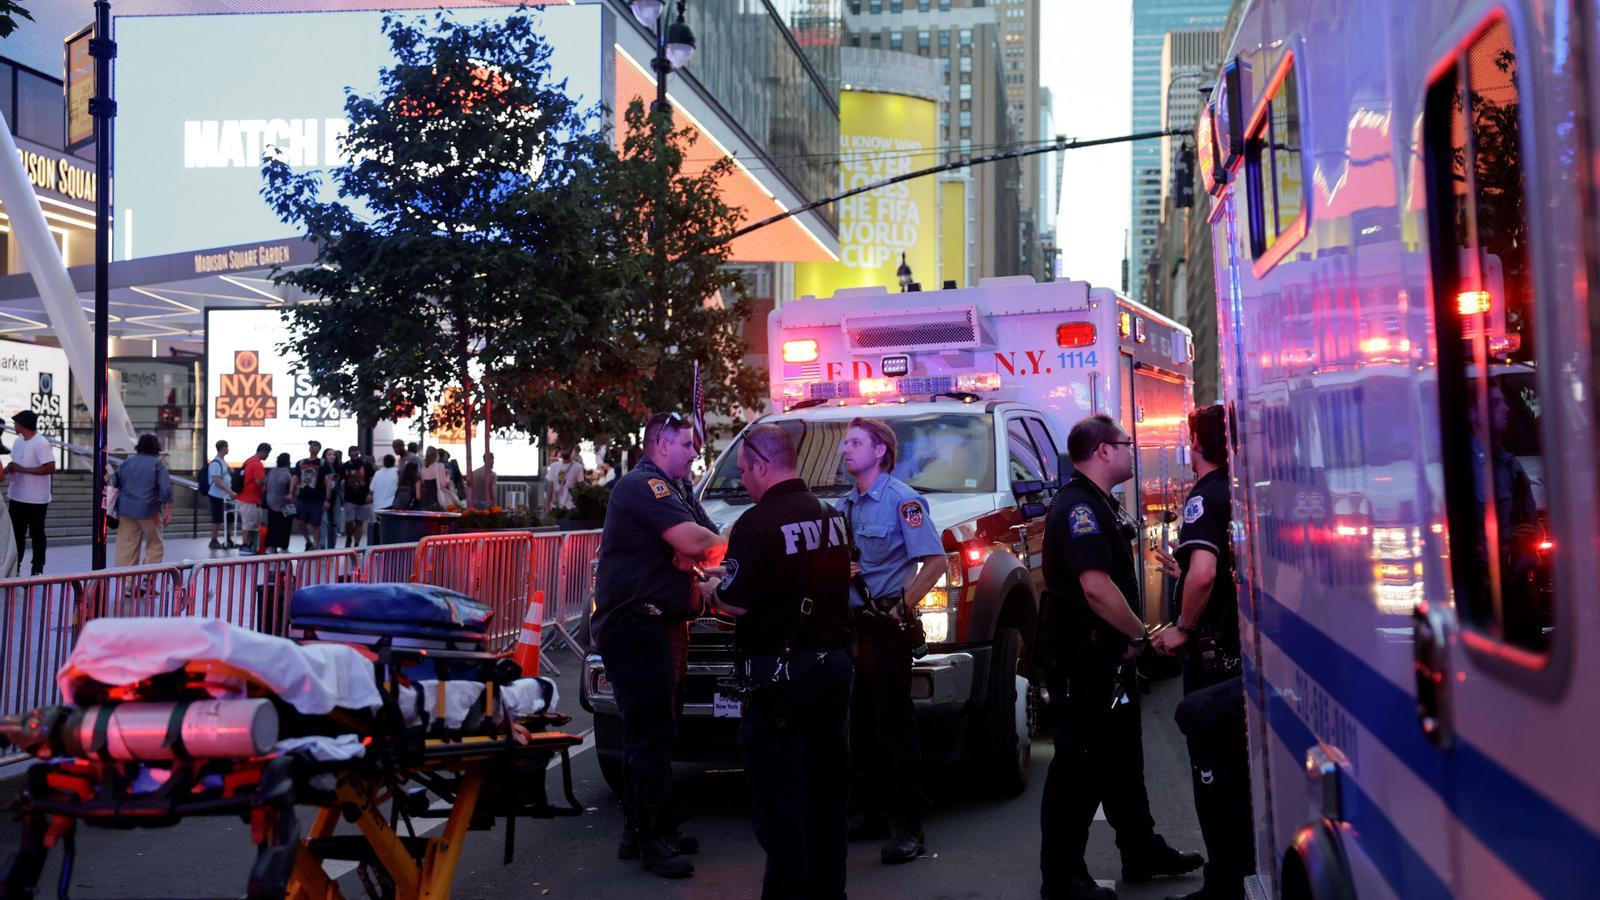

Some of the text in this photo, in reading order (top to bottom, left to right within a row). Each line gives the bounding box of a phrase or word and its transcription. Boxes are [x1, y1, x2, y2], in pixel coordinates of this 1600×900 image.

[184, 118, 318, 168] MATCH
[852, 135, 892, 150] KNOW
[840, 149, 912, 176] NEVER
[840, 172, 910, 199] LOSES
[878, 198, 920, 225] FIFA
[194, 245, 289, 273] MADISON SQUARE GARDEN
[993, 350, 1051, 376] N.Y.
[1057, 351, 1098, 369] 1114
[221, 374, 273, 396] NYK
[31, 394, 59, 415] SAS
[216, 397, 265, 419] 54%
[289, 397, 339, 419] 46%
[780, 516, 849, 555] FDNY
